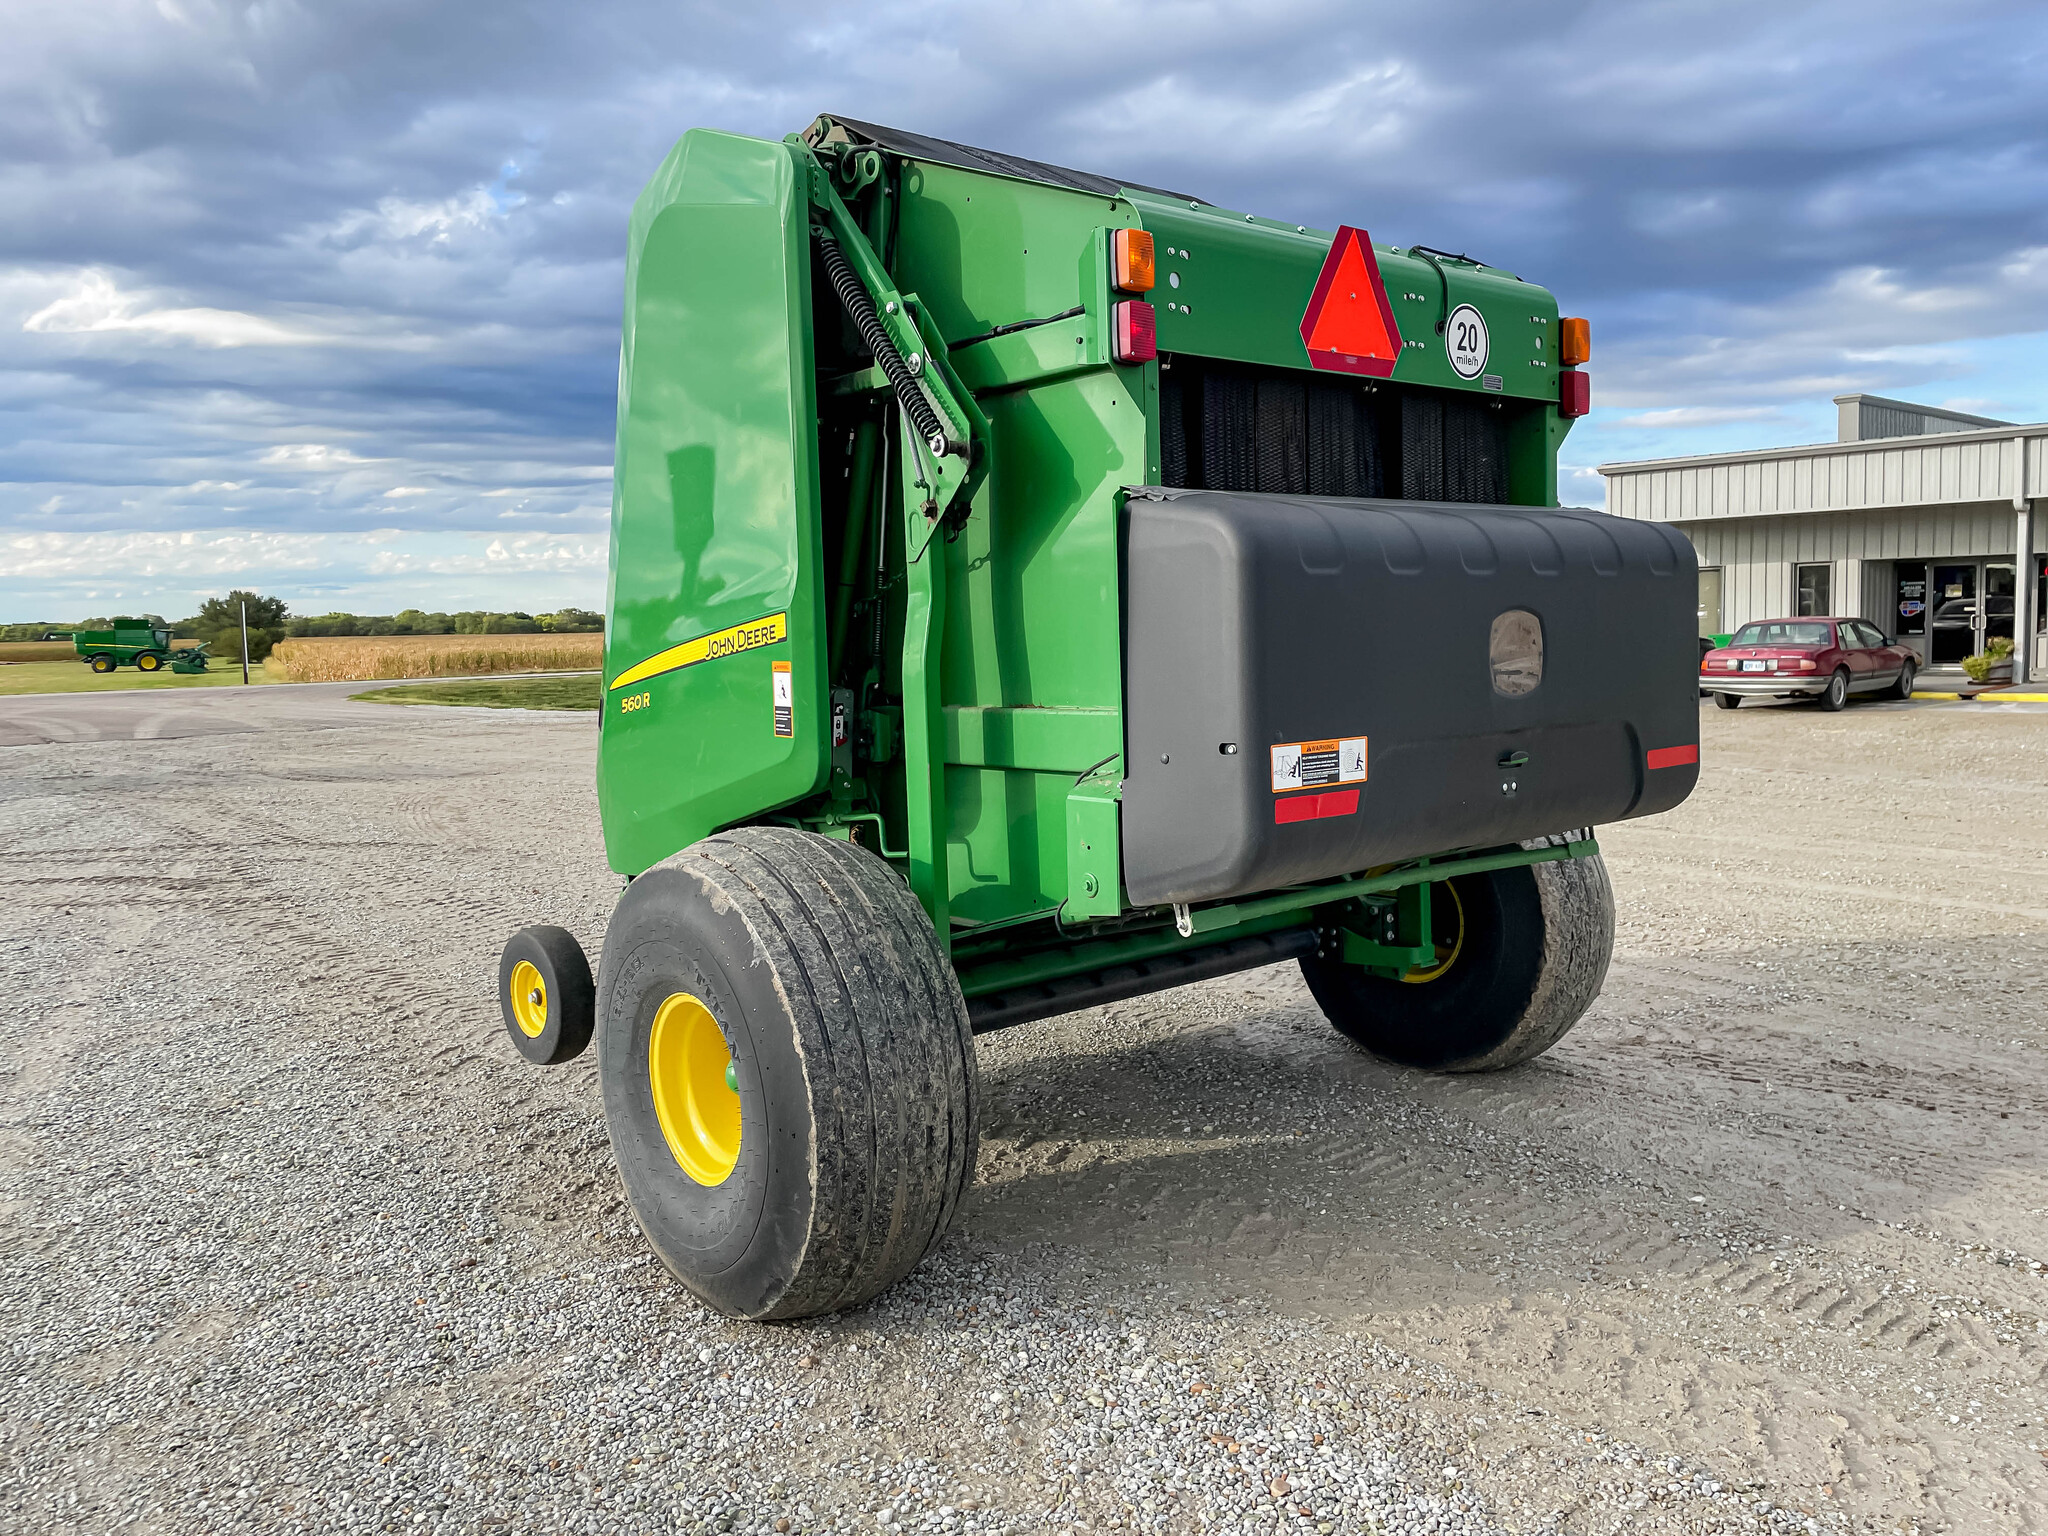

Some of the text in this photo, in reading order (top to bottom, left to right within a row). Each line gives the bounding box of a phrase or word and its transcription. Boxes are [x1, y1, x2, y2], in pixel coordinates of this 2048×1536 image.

[1457, 321, 1478, 353] 20
[1456, 355, 1479, 367] mile/h
[705, 624, 777, 658] JOHN DEERE
[621, 694, 642, 714] 560
[1311, 743, 1335, 751] WARNING
